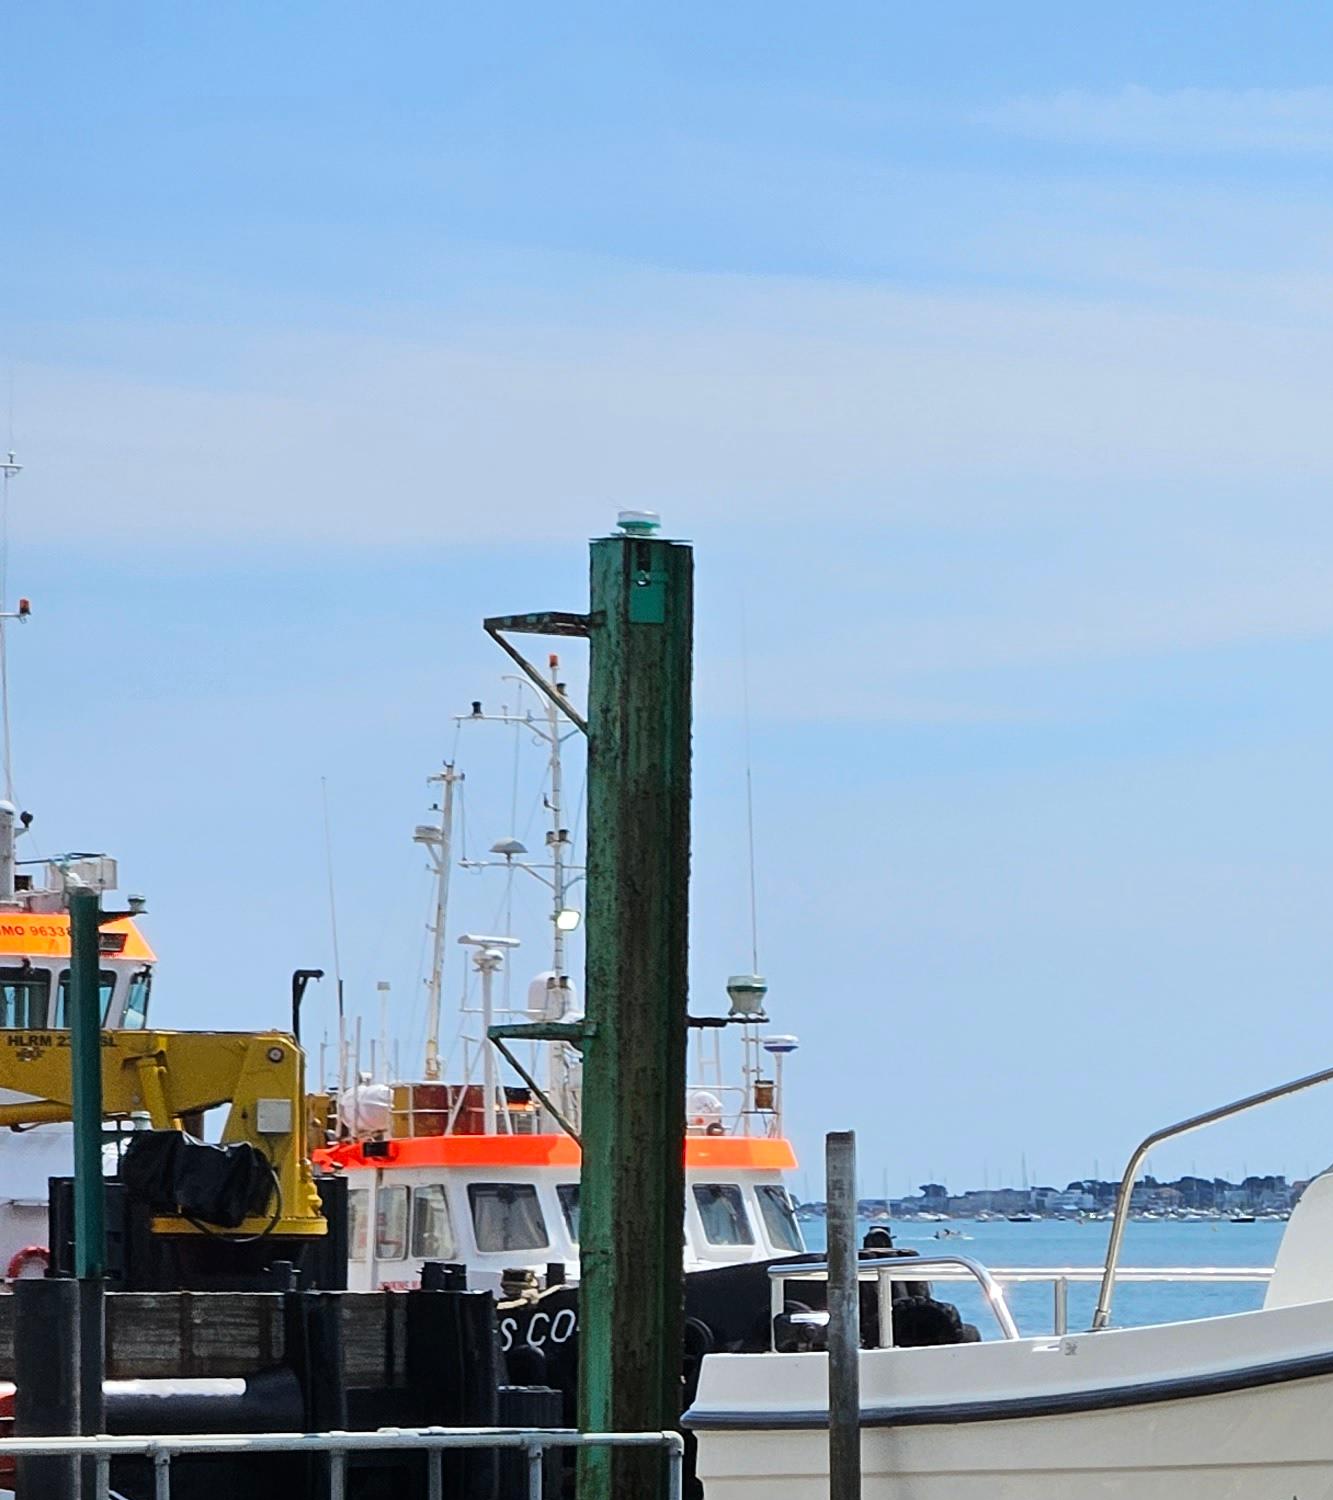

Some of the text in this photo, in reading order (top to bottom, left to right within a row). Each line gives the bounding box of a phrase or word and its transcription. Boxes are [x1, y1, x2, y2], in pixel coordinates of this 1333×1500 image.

[0, 925, 25, 936] MO
[7, 1035, 52, 1047] HLRM
[526, 1308, 579, 1347] CO
